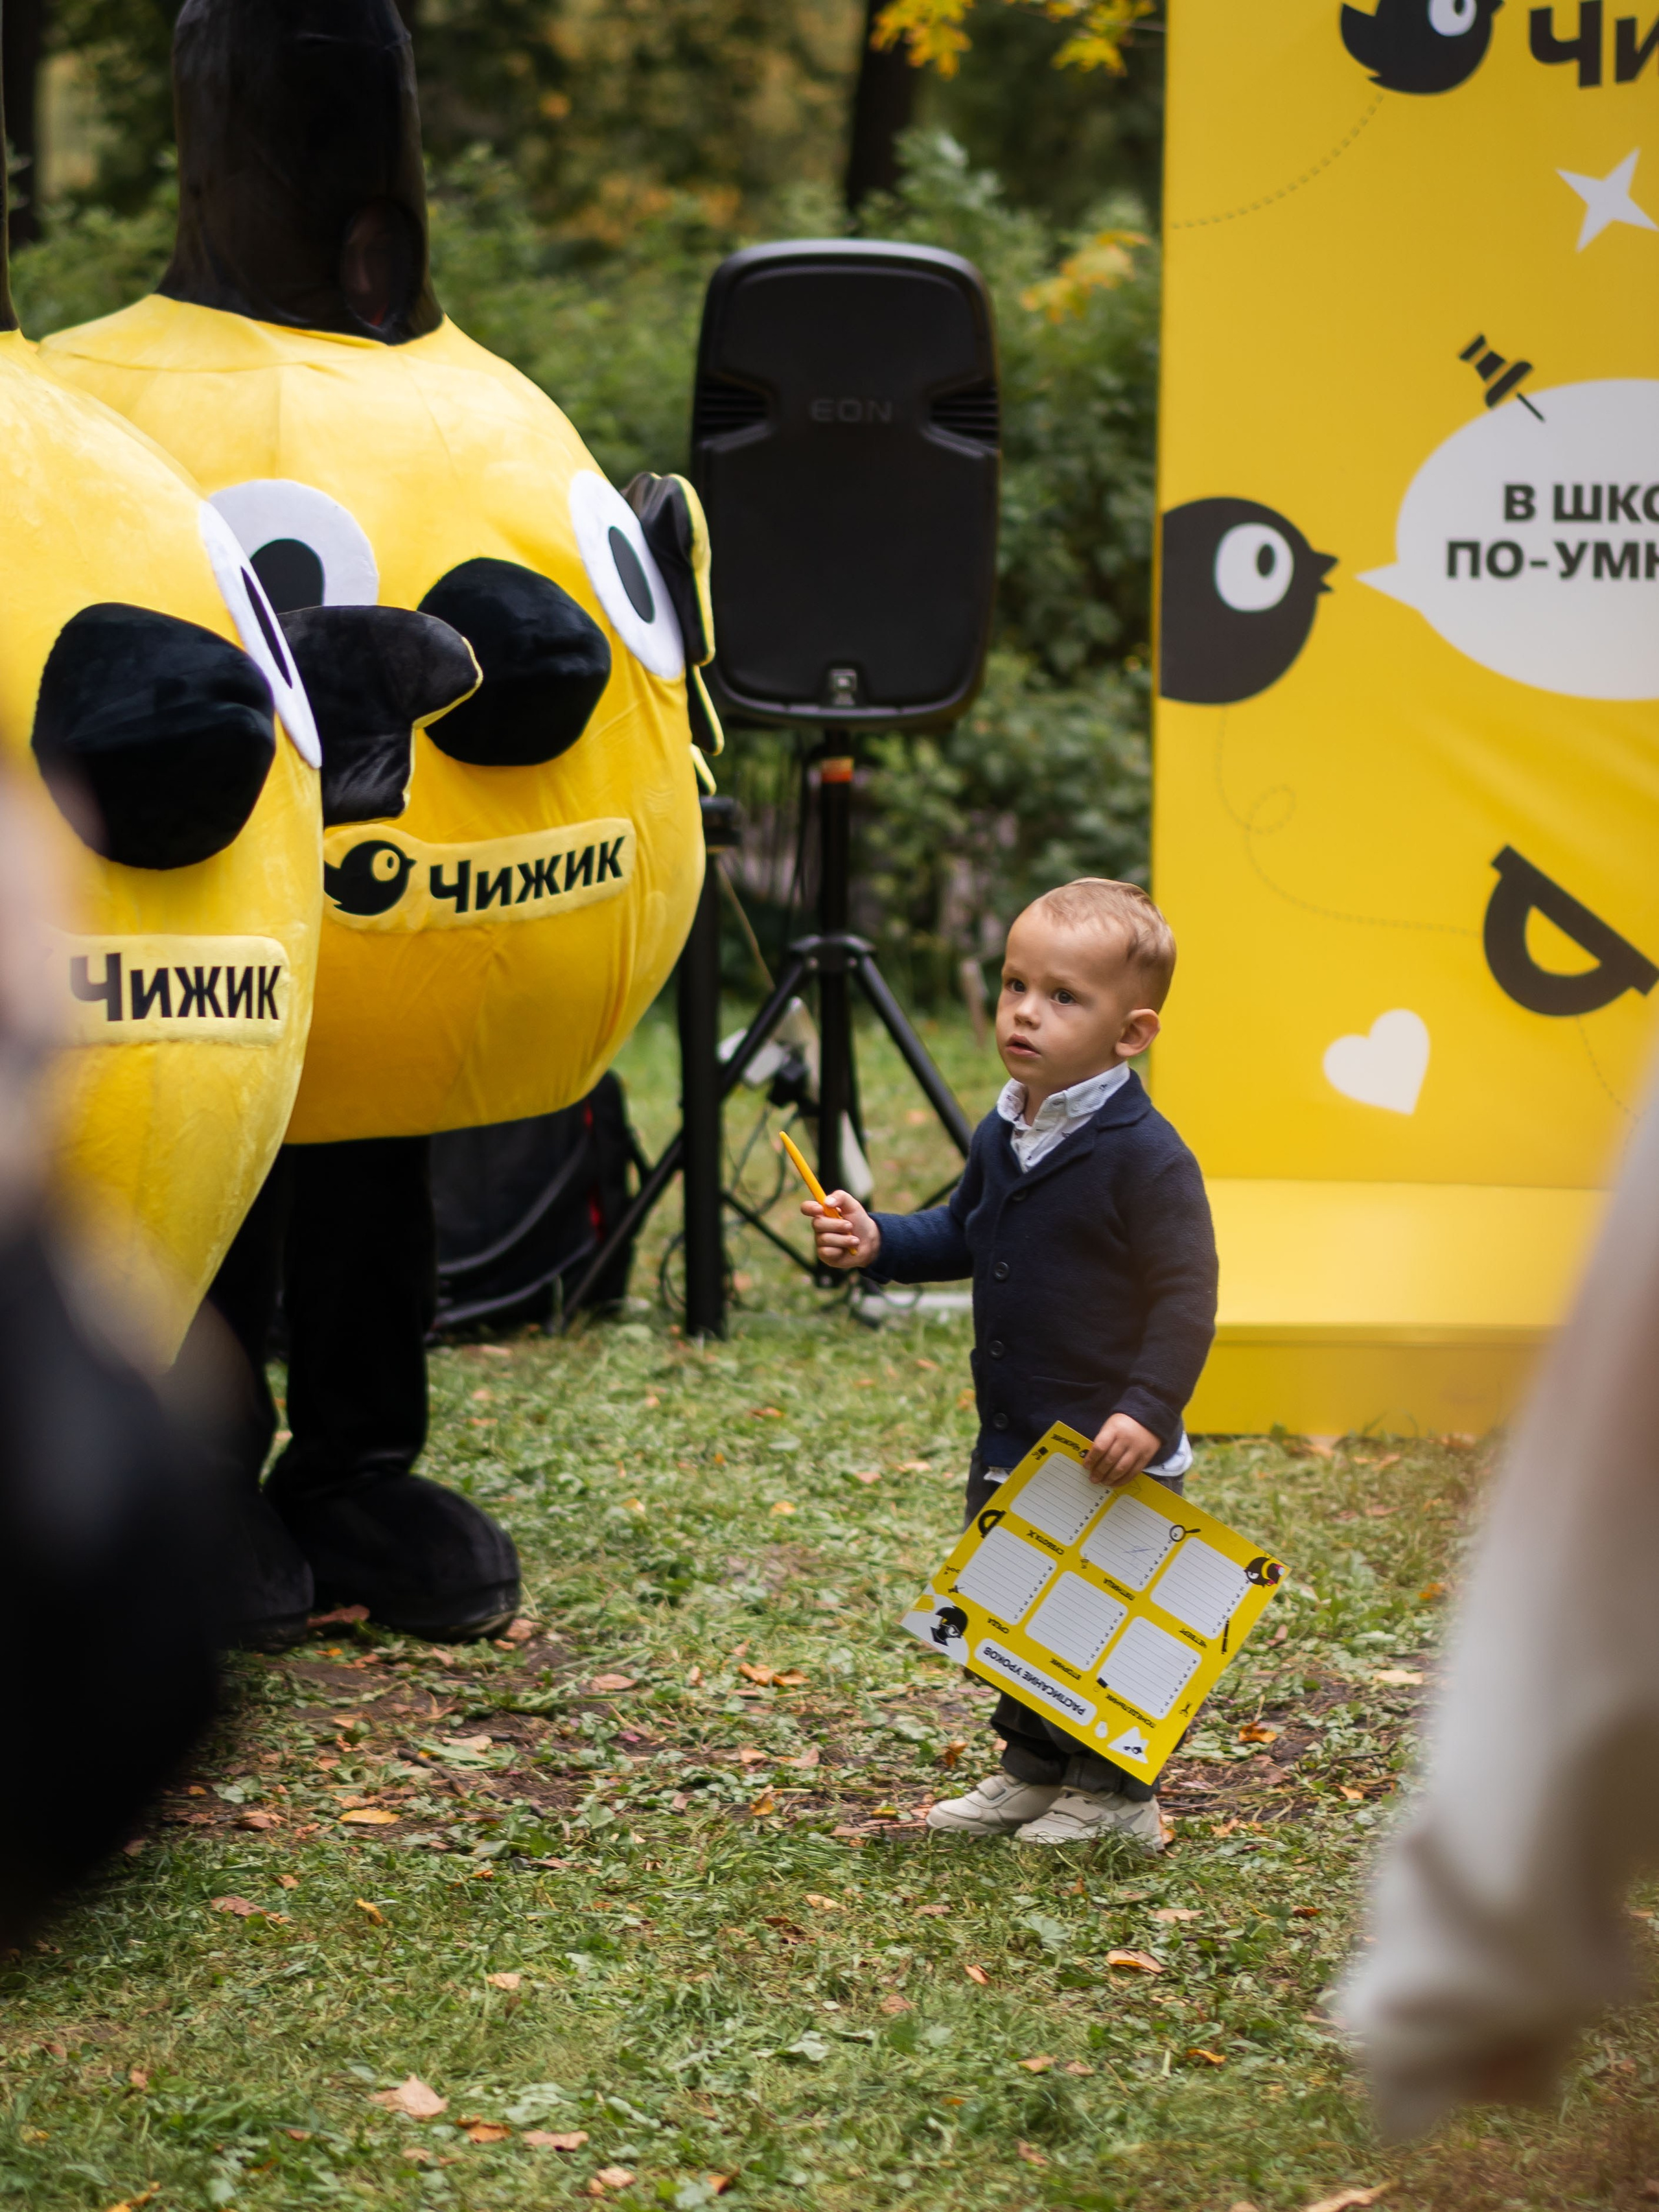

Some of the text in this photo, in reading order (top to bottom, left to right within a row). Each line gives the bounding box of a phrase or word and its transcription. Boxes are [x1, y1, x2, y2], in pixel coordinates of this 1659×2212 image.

[810, 398, 894, 423] EON
[1505, 484, 1535, 522] В
[428, 836, 623, 913] Чижик
[70, 953, 281, 1021] Чижик
[982, 1646, 1085, 1716] РАСПИСАНИЕ УРОКОВ
